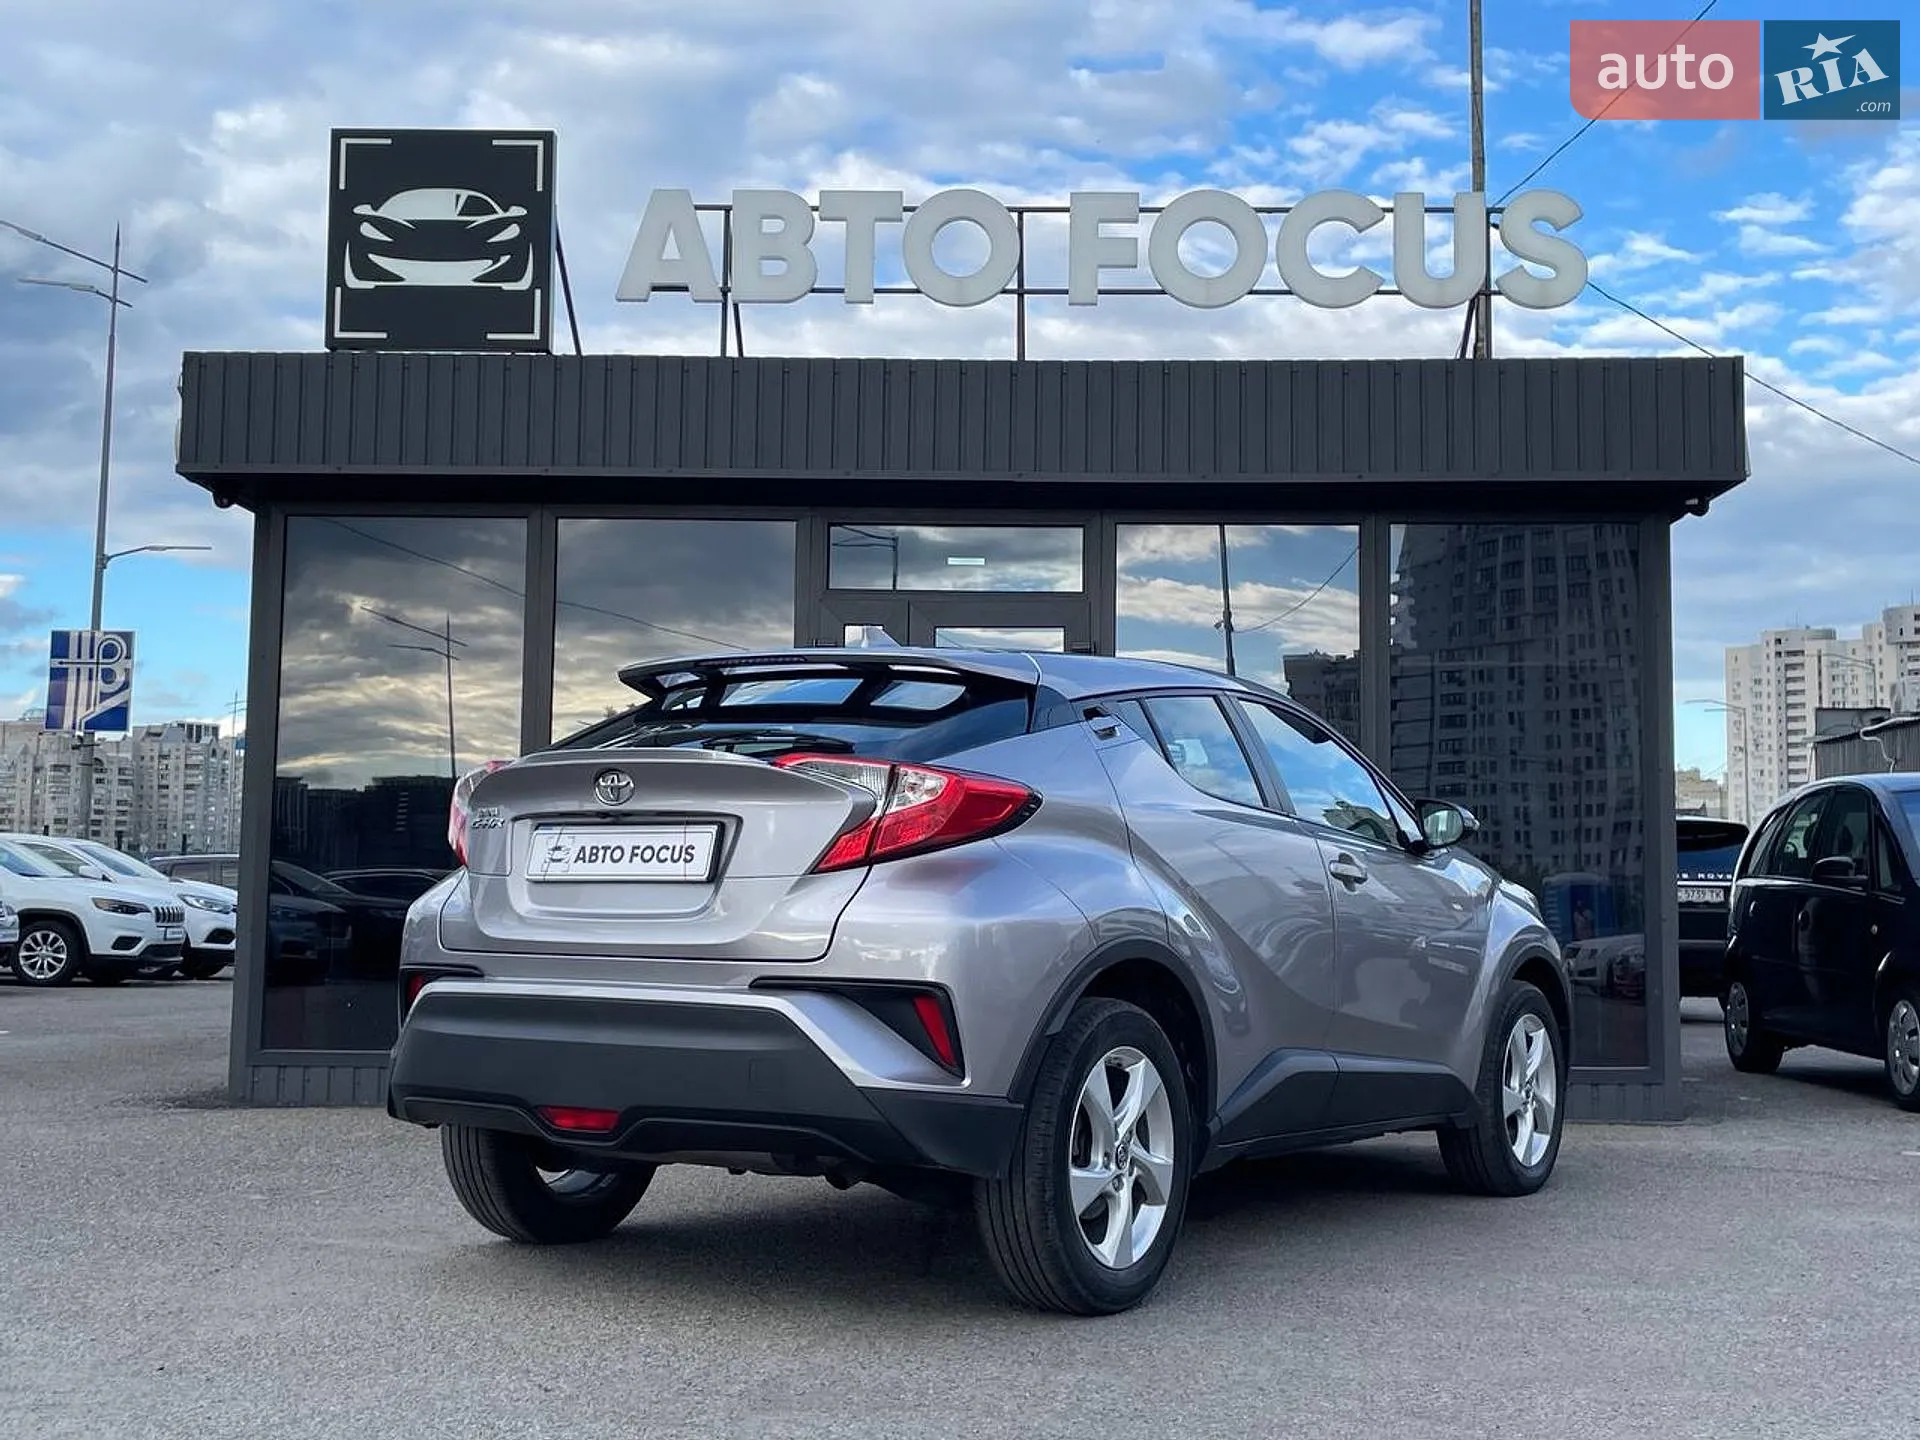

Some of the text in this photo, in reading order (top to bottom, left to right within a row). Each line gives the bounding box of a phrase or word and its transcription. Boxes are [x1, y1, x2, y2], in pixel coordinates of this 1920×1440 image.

[614, 187, 1590, 310] АВТО FOCUS
[573, 843, 696, 865] АВТО FOCUS
